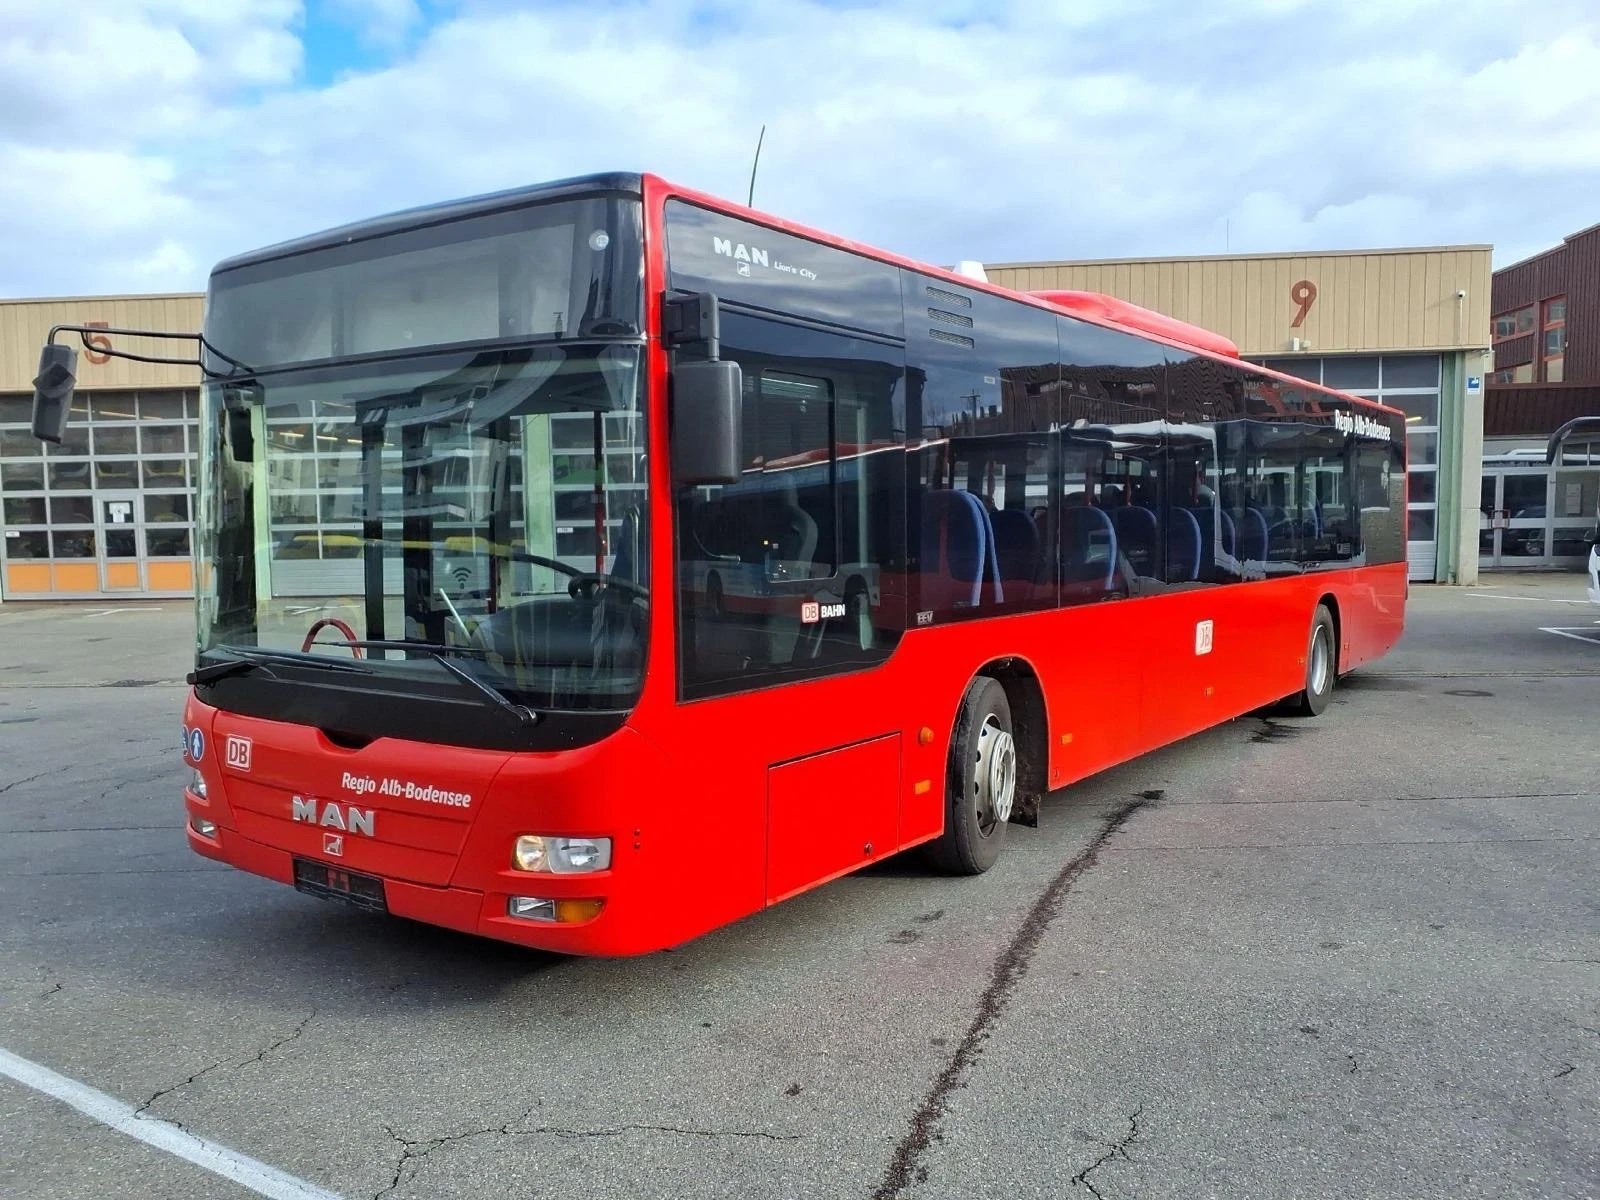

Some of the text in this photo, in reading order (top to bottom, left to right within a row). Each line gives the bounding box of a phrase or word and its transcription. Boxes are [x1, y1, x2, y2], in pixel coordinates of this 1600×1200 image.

[713, 236, 817, 280] MAN Lion's City
[1291, 280, 1317, 328] 9
[84, 322, 112, 365] 5
[1334, 409, 1391, 441] Regio Alb-Bodensee
[804, 604, 846, 620] DB BAHN
[228, 739, 249, 767] DB
[342, 772, 472, 808] Regio Alb-Bodensee
[292, 795, 375, 837] MAN
